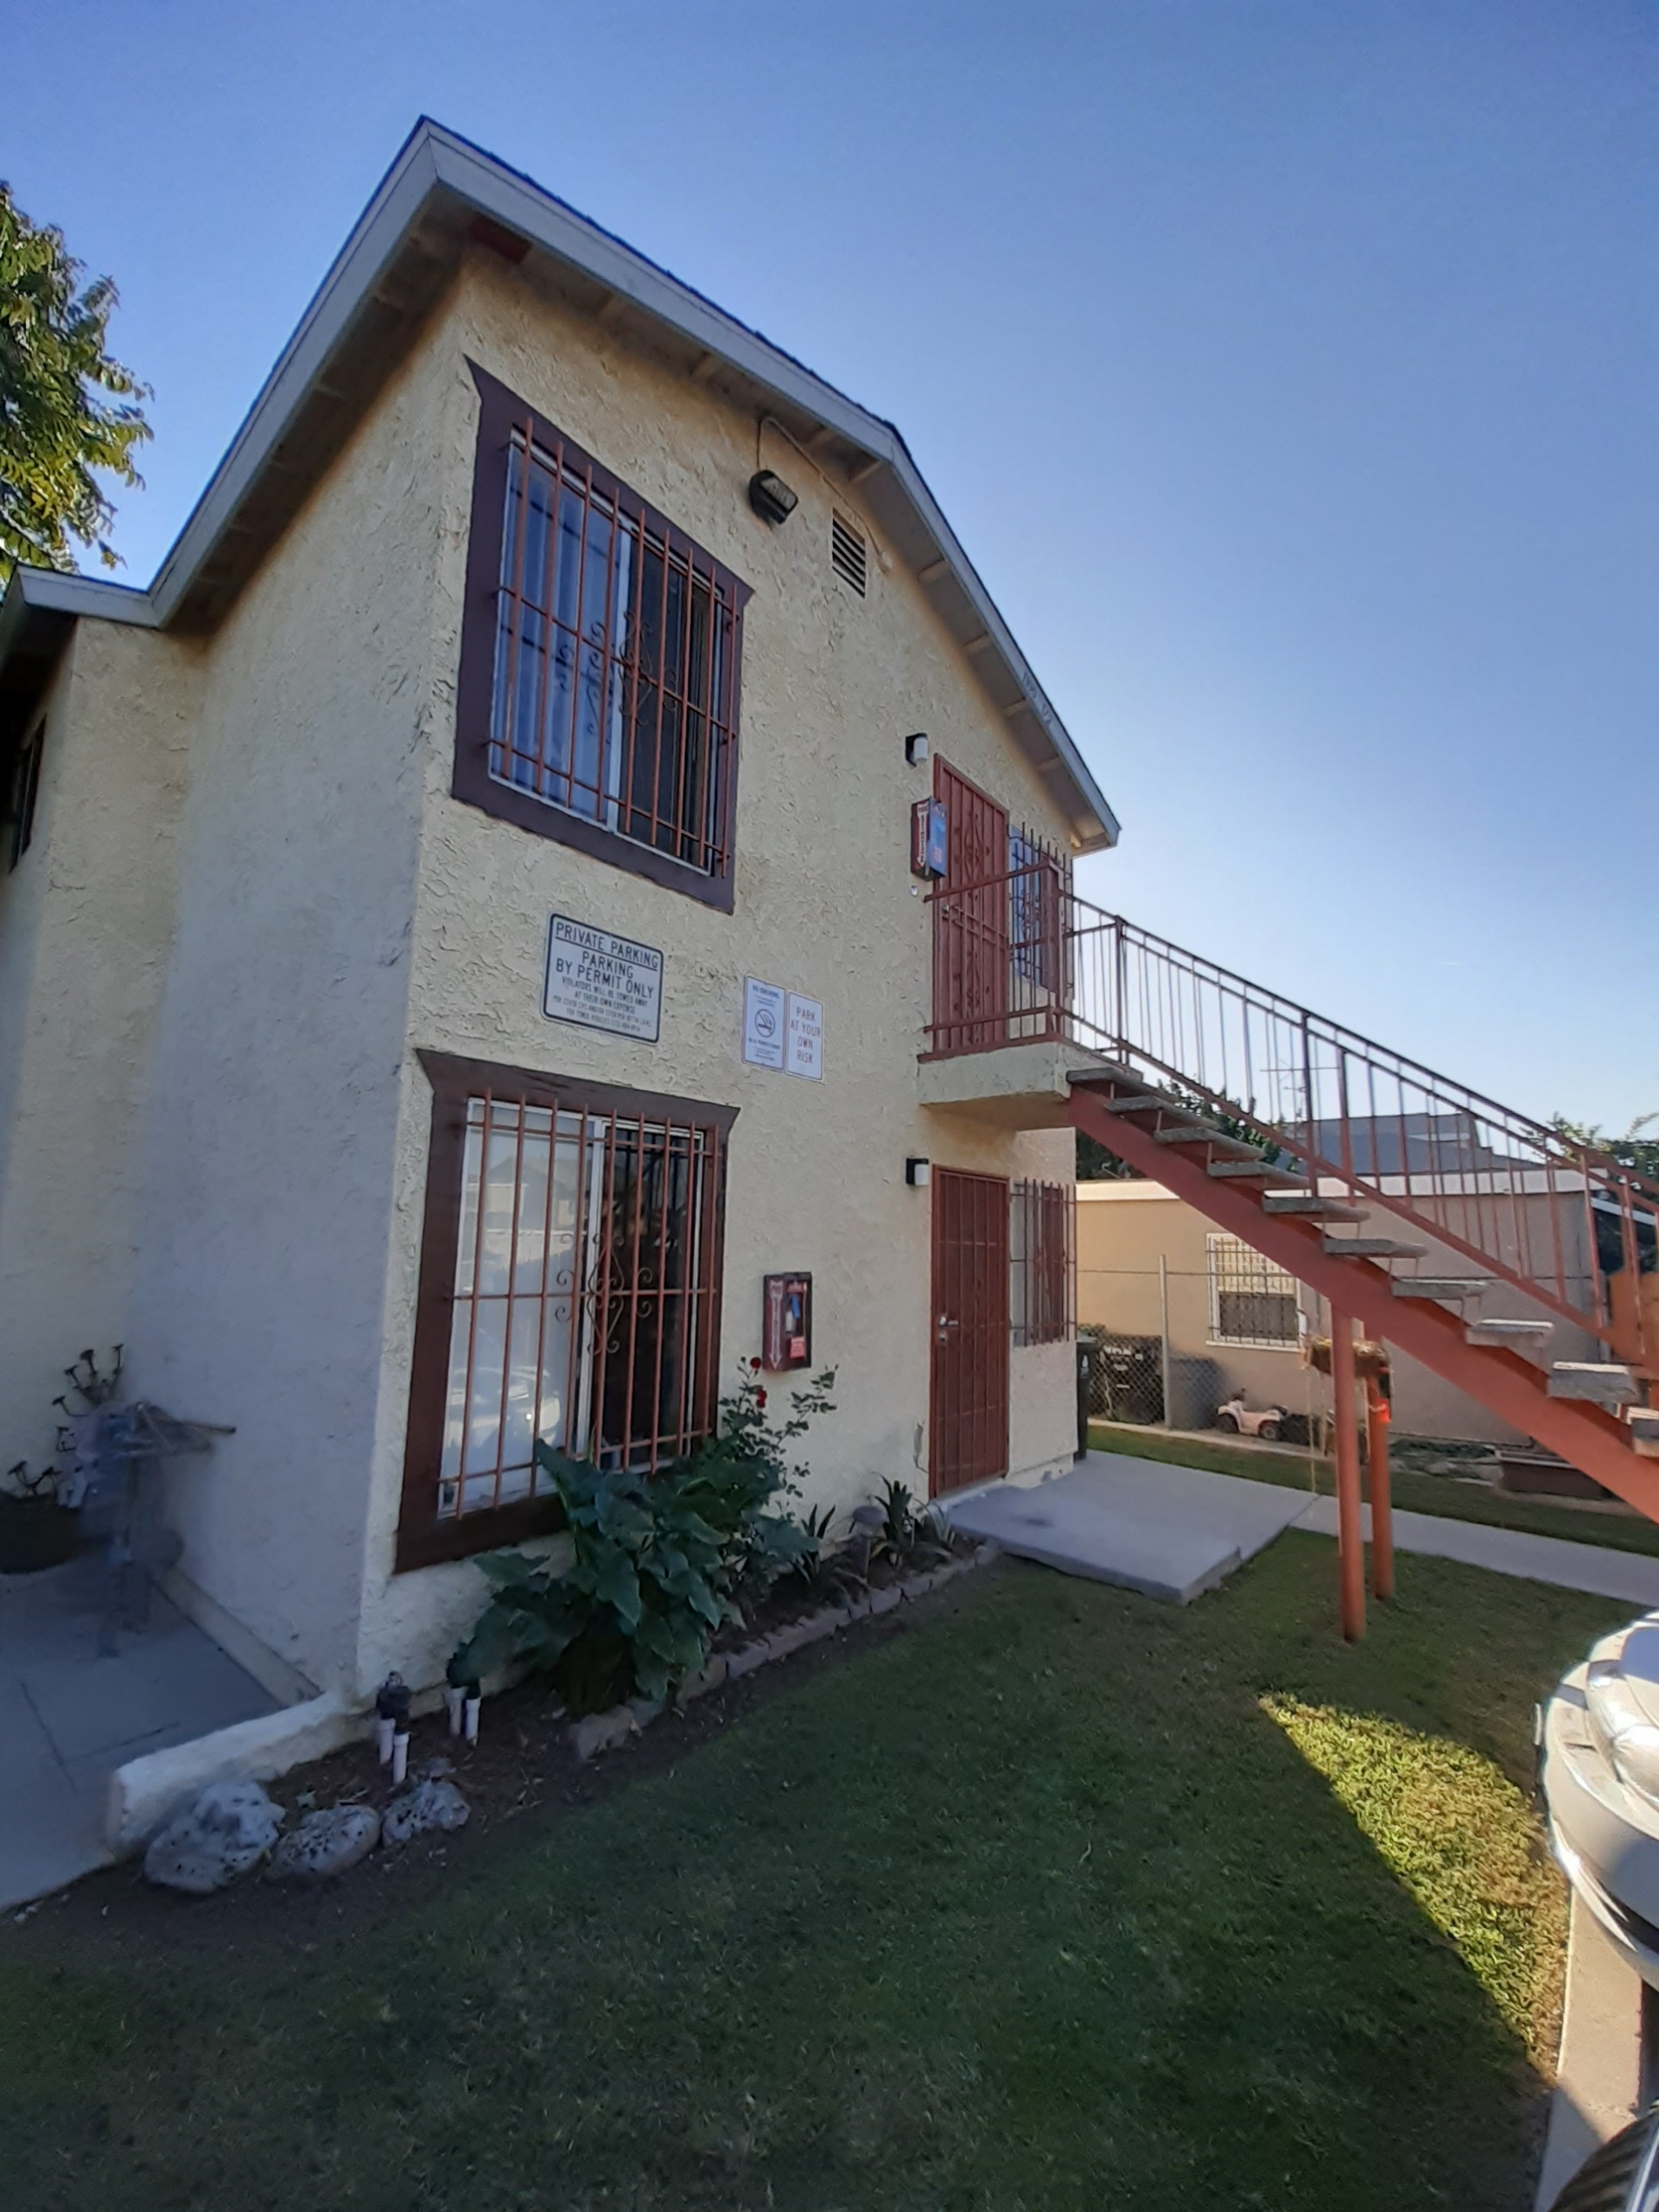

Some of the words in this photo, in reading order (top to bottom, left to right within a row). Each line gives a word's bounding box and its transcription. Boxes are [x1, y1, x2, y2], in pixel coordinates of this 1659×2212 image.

[556, 921, 605, 950] PRIVATE
[610, 941, 658, 969] PARKING
[582, 950, 633, 978] PARKING
[556, 958, 573, 974] BY
[577, 965, 622, 989] PERMIT
[626, 980, 654, 999] ONLY
[562, 976, 592, 991] VIOLATORS
[594, 986, 606, 996] WILL
[582, 993, 598, 1004] THEIR
[600, 998, 612, 1007] OWN
[613, 1001, 635, 1014] EXPENSE
[796, 1007, 816, 1022] PARK
[791, 1020, 799, 1031] AT
[802, 1025, 821, 1038] YOUR
[798, 1036, 813, 1050] OWN
[797, 1050, 813, 1064] RISK
